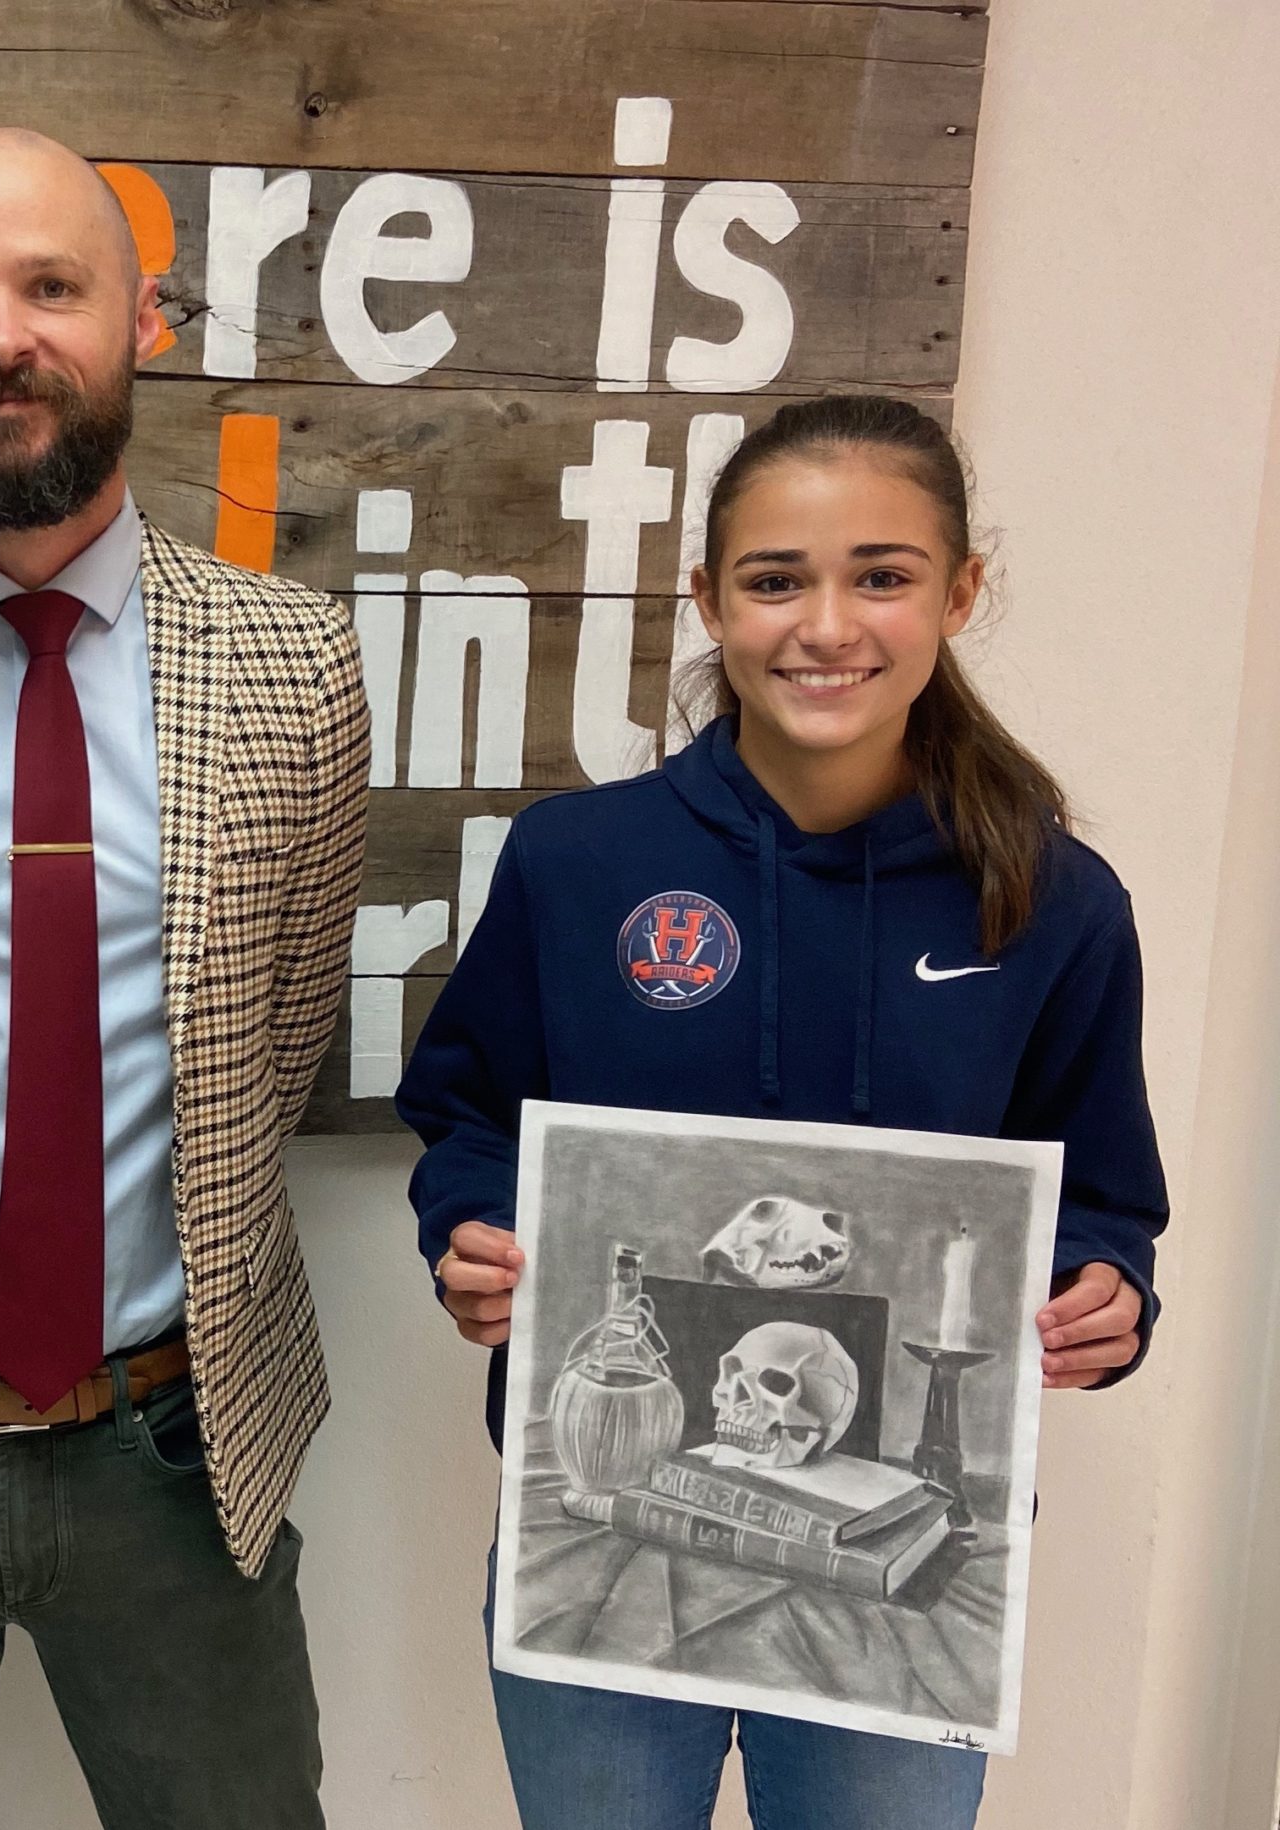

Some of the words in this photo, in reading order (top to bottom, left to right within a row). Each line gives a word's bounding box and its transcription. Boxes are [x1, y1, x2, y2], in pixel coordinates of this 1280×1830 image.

[596, 97, 801, 392] is
[356, 488, 531, 788] in
[650, 964, 696, 980] RAIDERS
[654, 906, 708, 961] H
